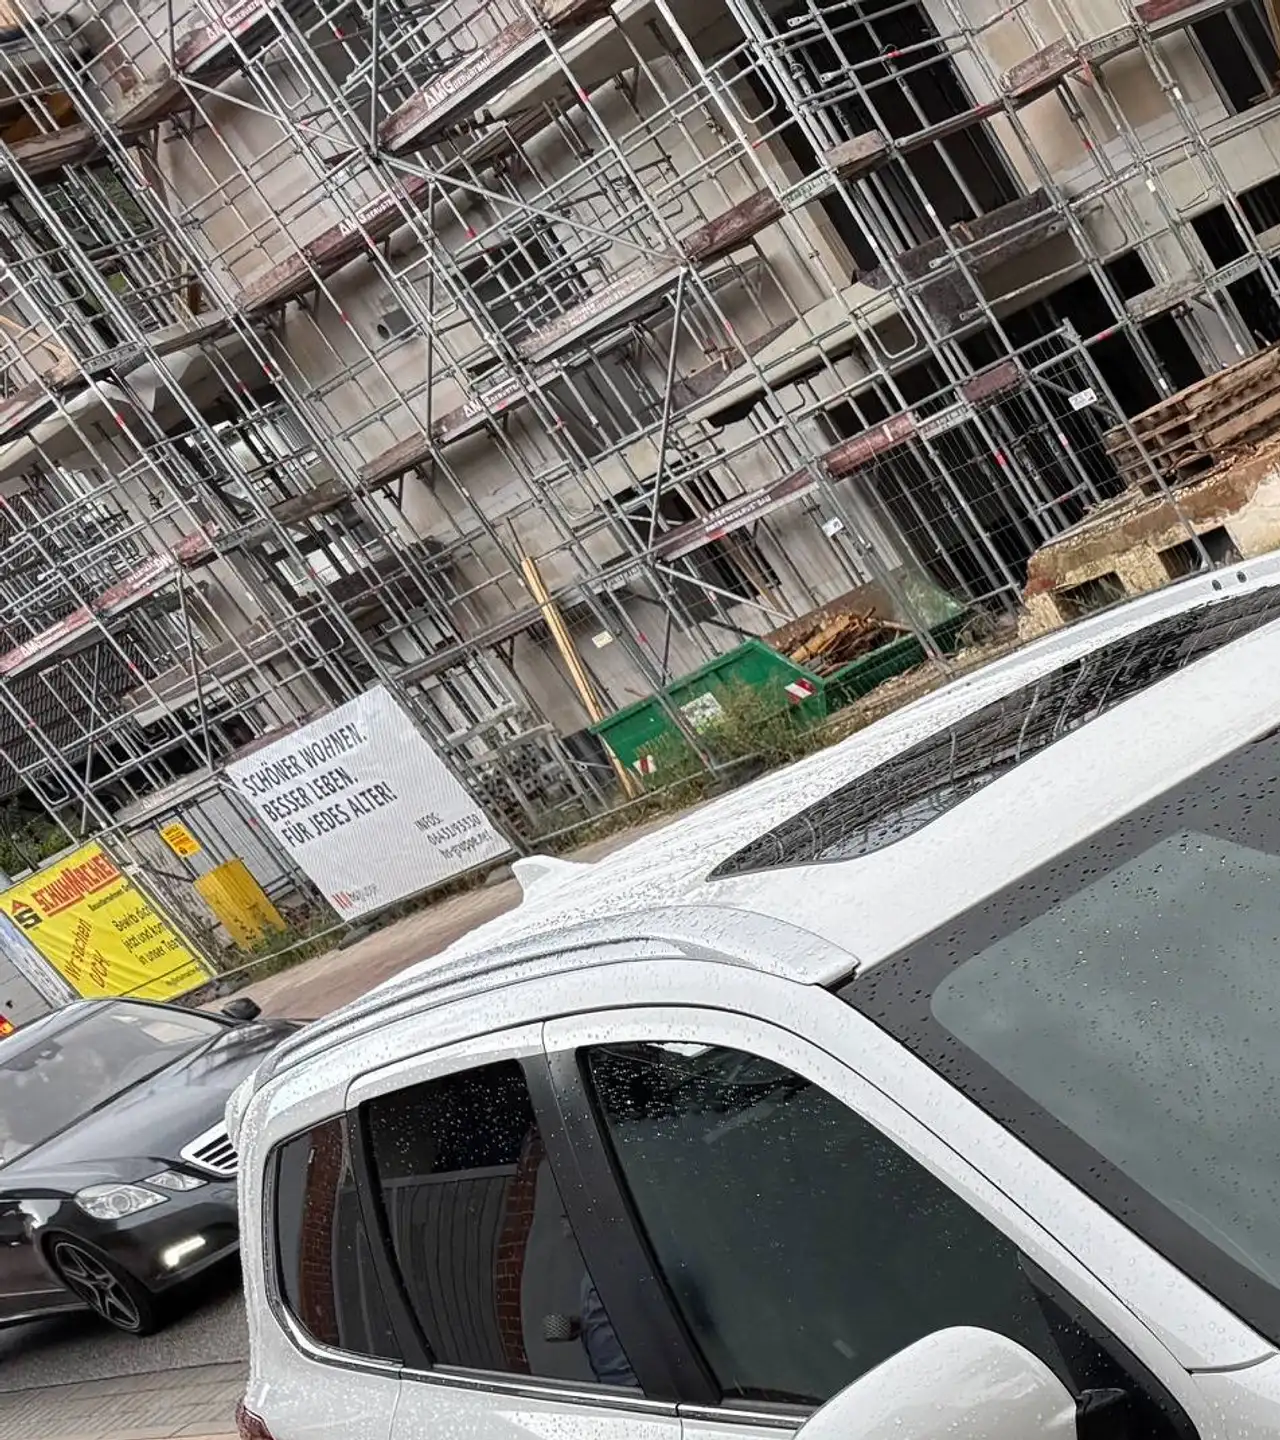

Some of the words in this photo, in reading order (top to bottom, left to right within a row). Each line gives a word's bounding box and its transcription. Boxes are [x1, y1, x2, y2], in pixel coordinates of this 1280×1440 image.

[242, 754, 306, 797] SCHÖNER
[300, 722, 368, 769] WOHNEN.
[262, 782, 314, 822] BESSER
[281, 820, 315, 848] FÜR
[308, 803, 350, 836] JEDES
[347, 781, 398, 819] ALTER!
